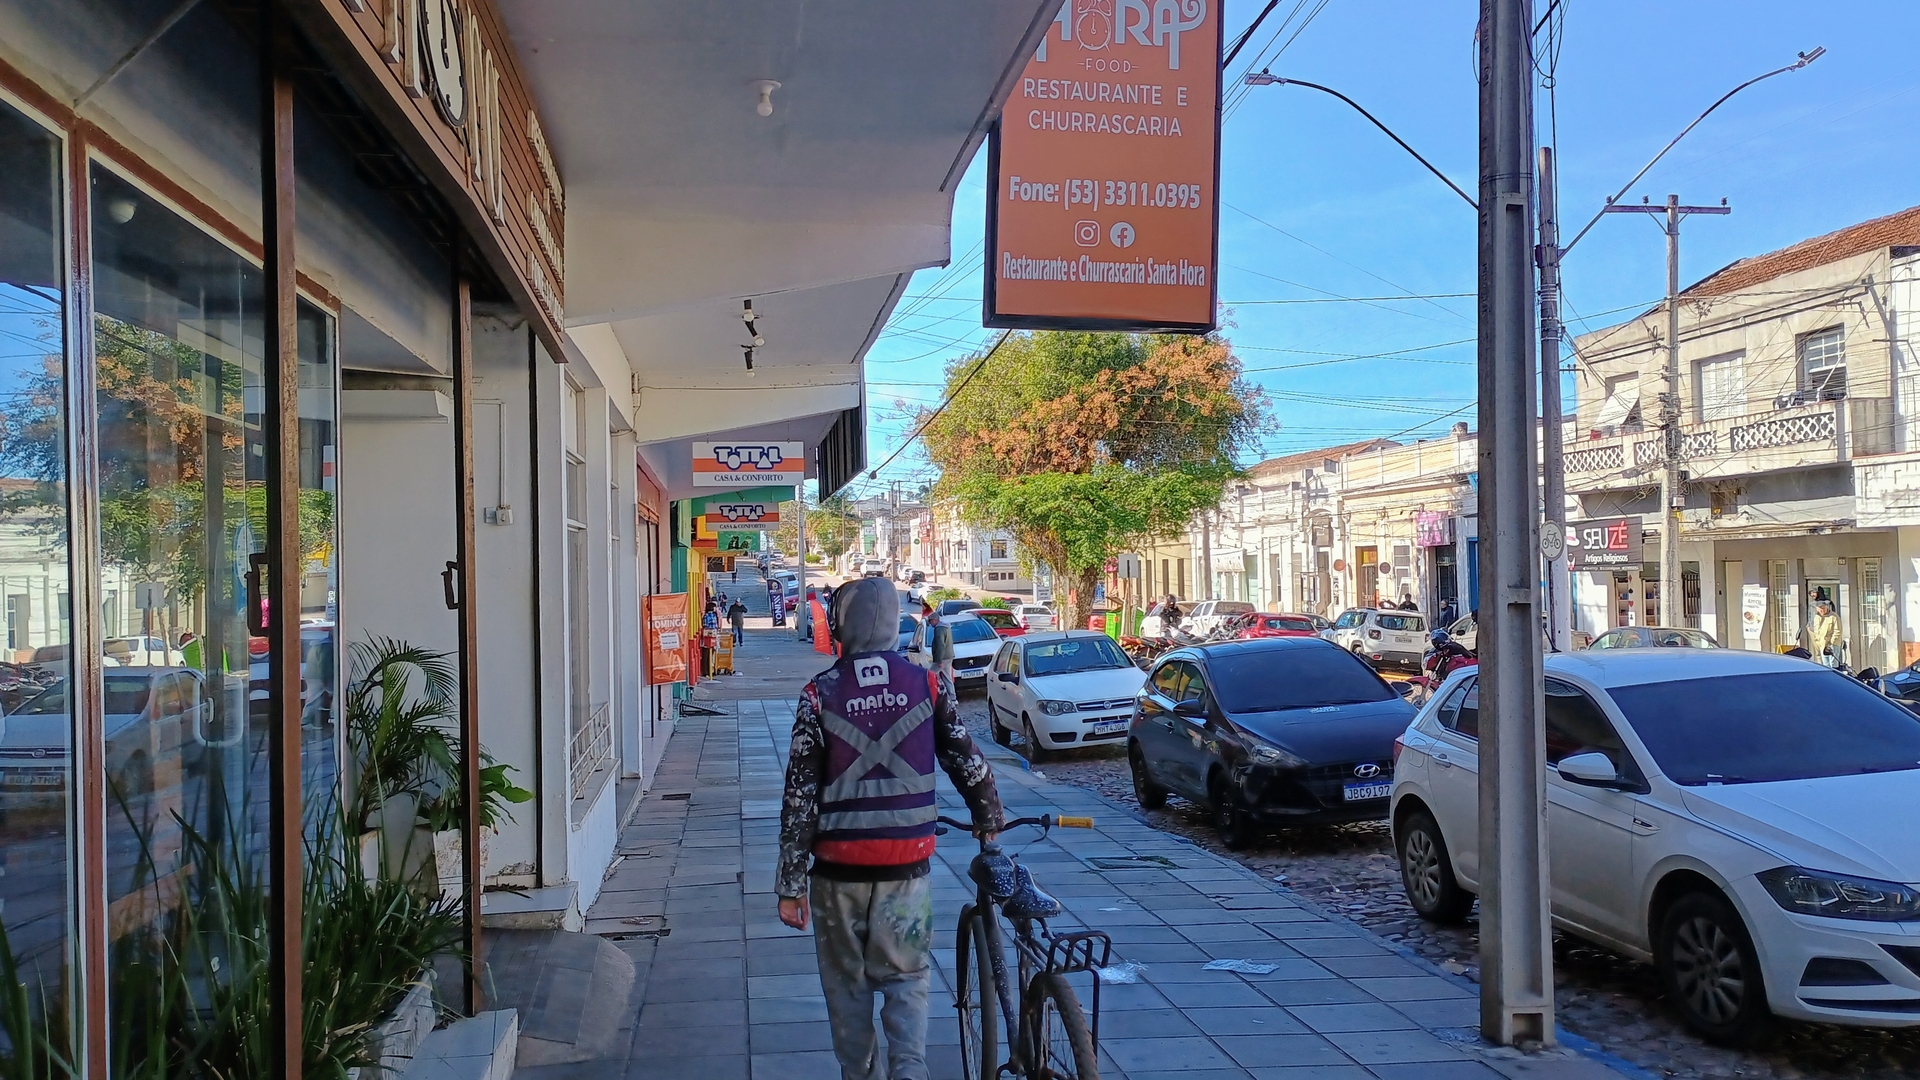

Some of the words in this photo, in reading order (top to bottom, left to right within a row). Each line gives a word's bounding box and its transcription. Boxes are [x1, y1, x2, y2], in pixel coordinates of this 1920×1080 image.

[1023, 78, 1162, 105] RESTAURANTE
[1177, 87, 1188, 106] E
[1028, 110, 1182, 137] CHURRASCARIA
[1009, 176, 1059, 202] Fone:
[1064, 179, 1099, 212] (53)
[1104, 181, 1201, 209] 3311.0395
[1002, 252, 1068, 281] Restaurante
[1069, 265, 1076, 281] e
[1078, 255, 1145, 284] Churrascaria
[1147, 257, 1177, 286] Santa
[1179, 259, 1205, 287] Hora
[714, 474, 733, 482] CASA
[734, 474, 741, 482] &
[742, 474, 783, 482] CONFORTO
[1585, 554, 1602, 565] Artigos
[1602, 552, 1629, 565] Religiosos
[648, 618, 687, 630] DOMINGO
